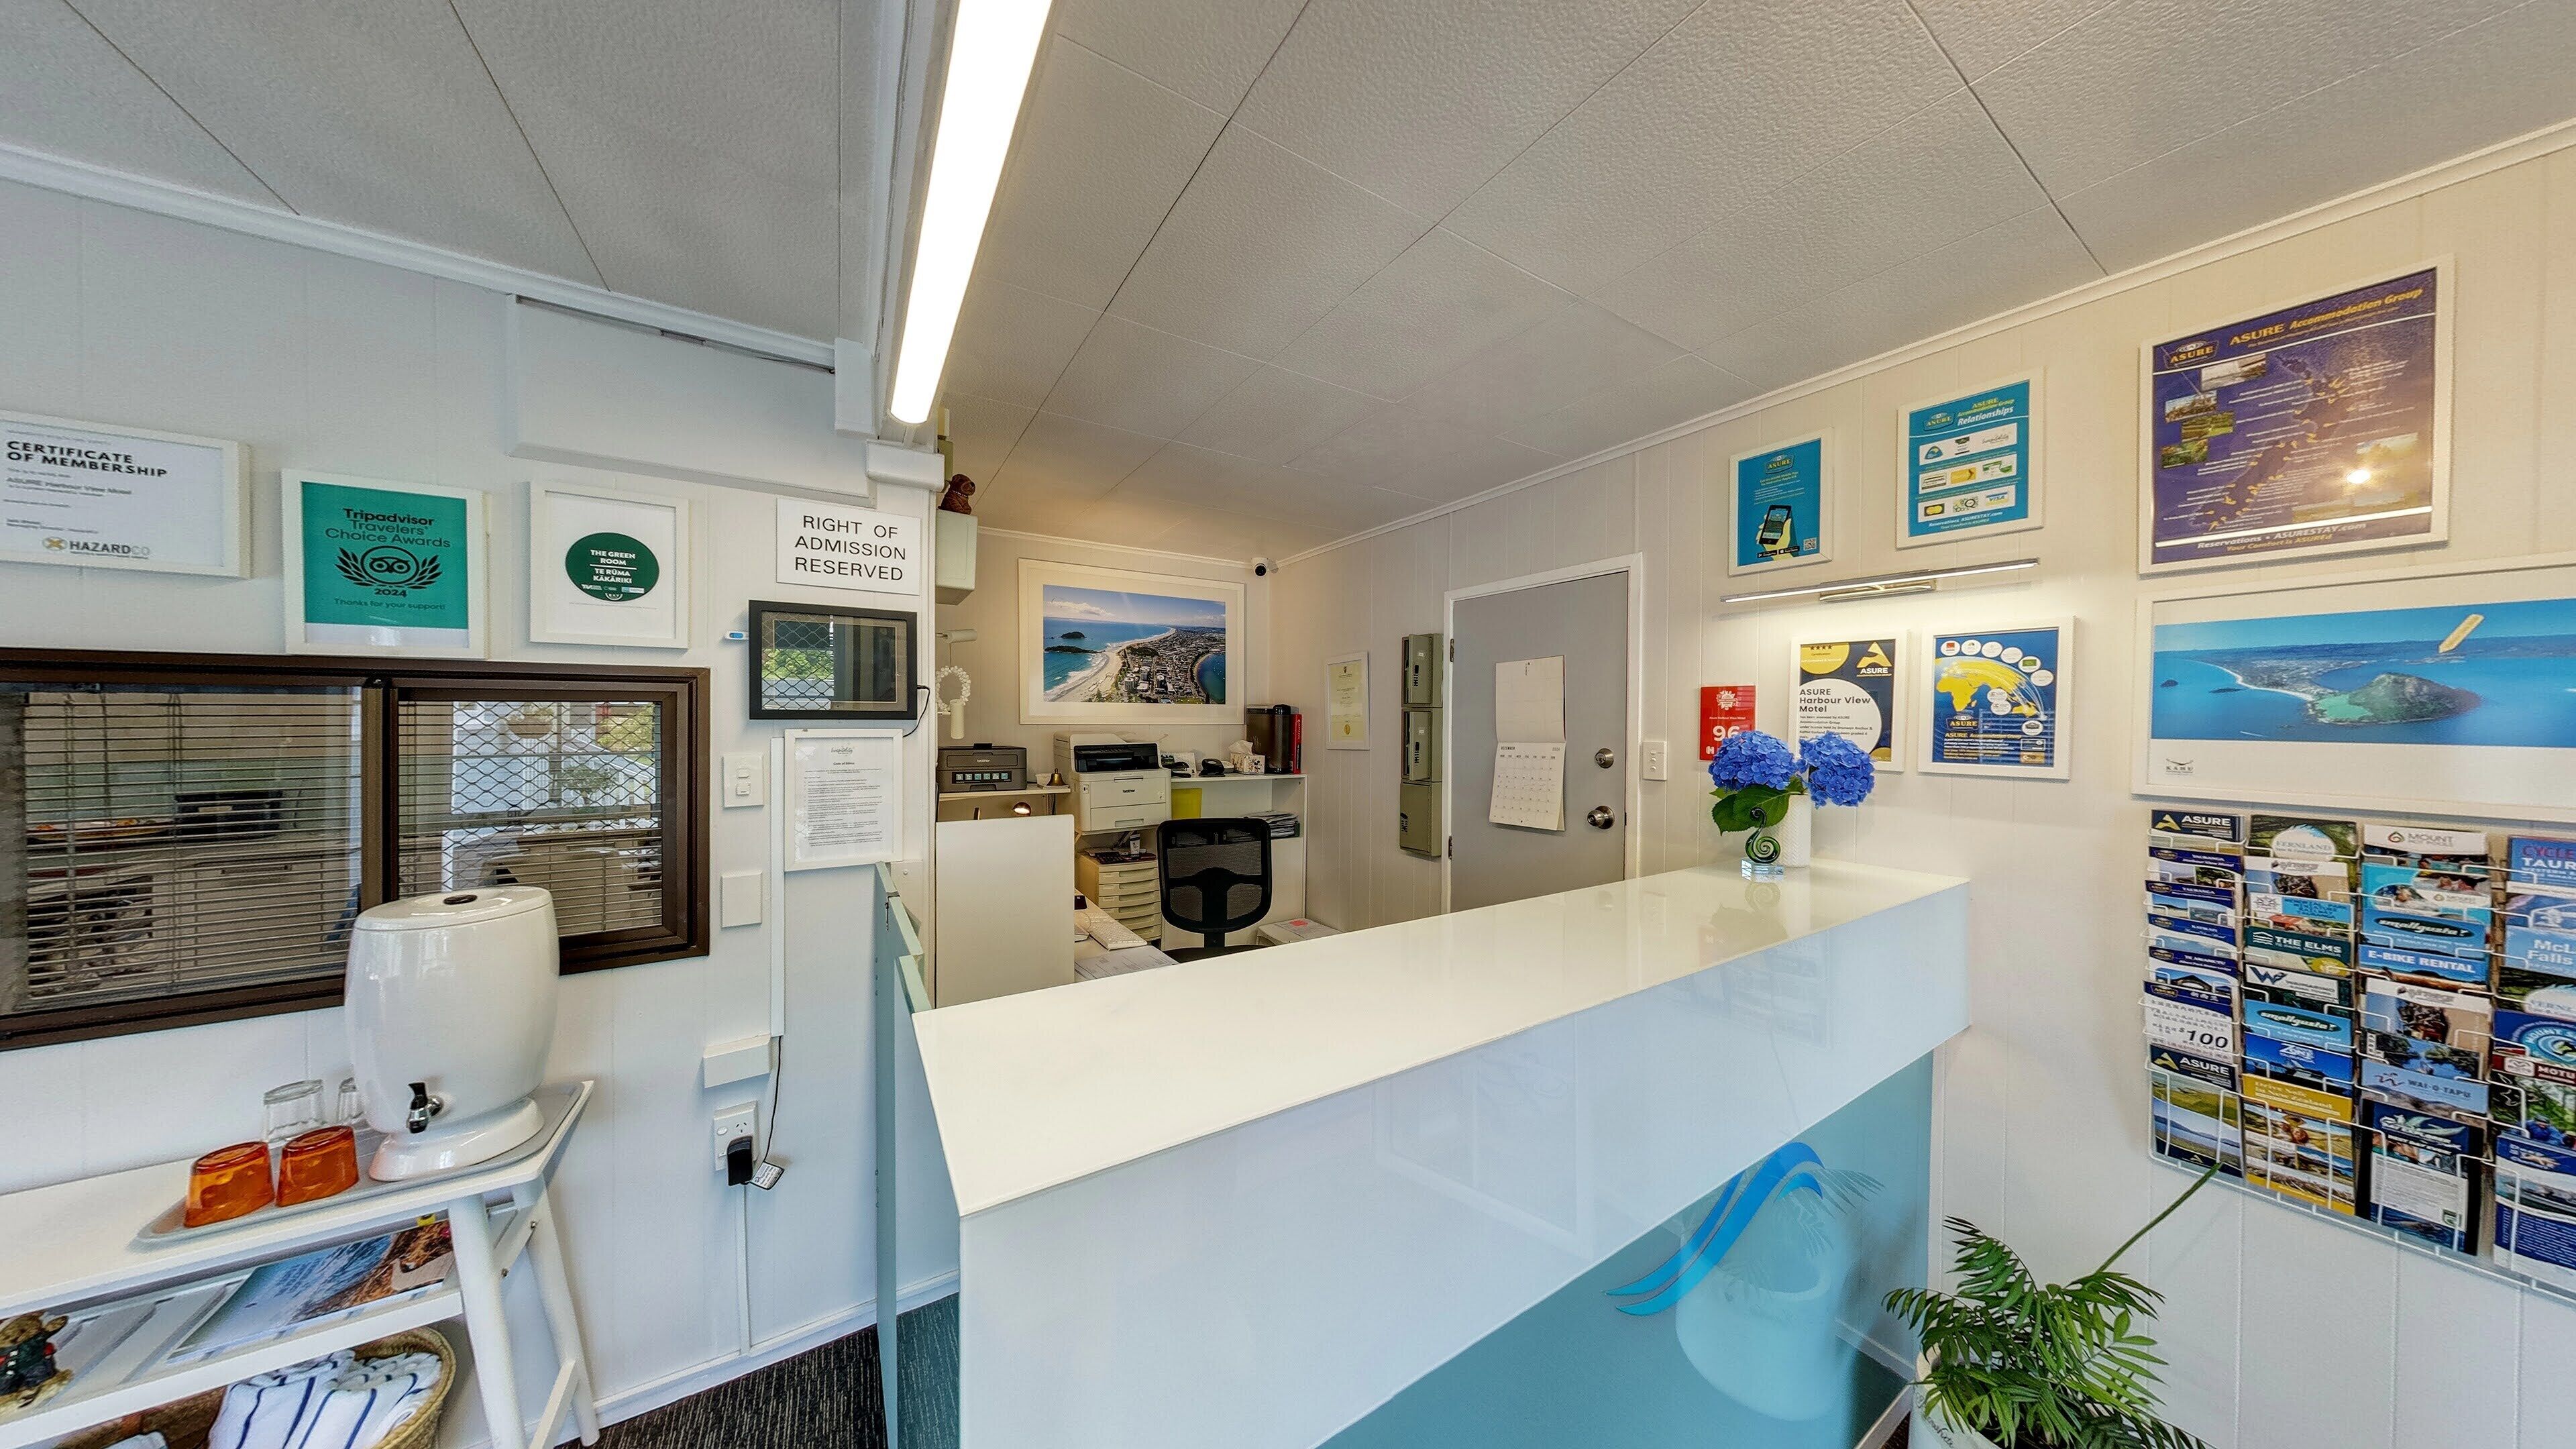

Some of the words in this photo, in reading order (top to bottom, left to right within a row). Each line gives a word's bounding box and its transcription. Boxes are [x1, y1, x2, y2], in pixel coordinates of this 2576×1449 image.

[2229, 323, 2286, 345] ASURE
[2290, 300, 2382, 329] Accommodation
[2384, 288, 2424, 304] Group
[2169, 346, 2214, 364] ASURE
[1957, 406, 2015, 426] Relationships
[7, 440, 134, 464] CERTIFICATE
[7, 451, 34, 462] OF
[42, 455, 168, 477] MEMBERSHIP
[1768, 459, 1791, 470] ASURE
[343, 507, 435, 526] Tripadvisor
[350, 519, 429, 535] Travelers'
[802, 515, 863, 535] RIGHT
[873, 525, 898, 539] OF
[2197, 535, 2262, 549] Reservations
[2273, 523, 2367, 539] ASURESTAY.com
[325, 527, 388, 543] Choice
[391, 534, 451, 547] Awards
[2248, 540, 2285, 550] Comfort
[590, 549, 606, 557] THE
[608, 551, 636, 559] GREEN
[794, 535, 906, 561] ADMISSION
[600, 557, 627, 566] ROOM
[794, 556, 904, 581] RESERVED
[334, 598, 368, 606] Thanks
[374, 588, 407, 598] 2024
[2181, 814, 2231, 826] ASURE
[2276, 841, 2332, 851] FERNLAND
[2275, 936, 2302, 947] THE
[2304, 941, 2343, 953] ELMS
[2367, 949, 2415, 964] E-BIKE
[2419, 957, 2476, 973] RENTAL
[2527, 949, 2574, 965] Falls
[2180, 1057, 2231, 1075] ASURE
[2408, 1079, 2471, 1098] WAI-O-TAPU
